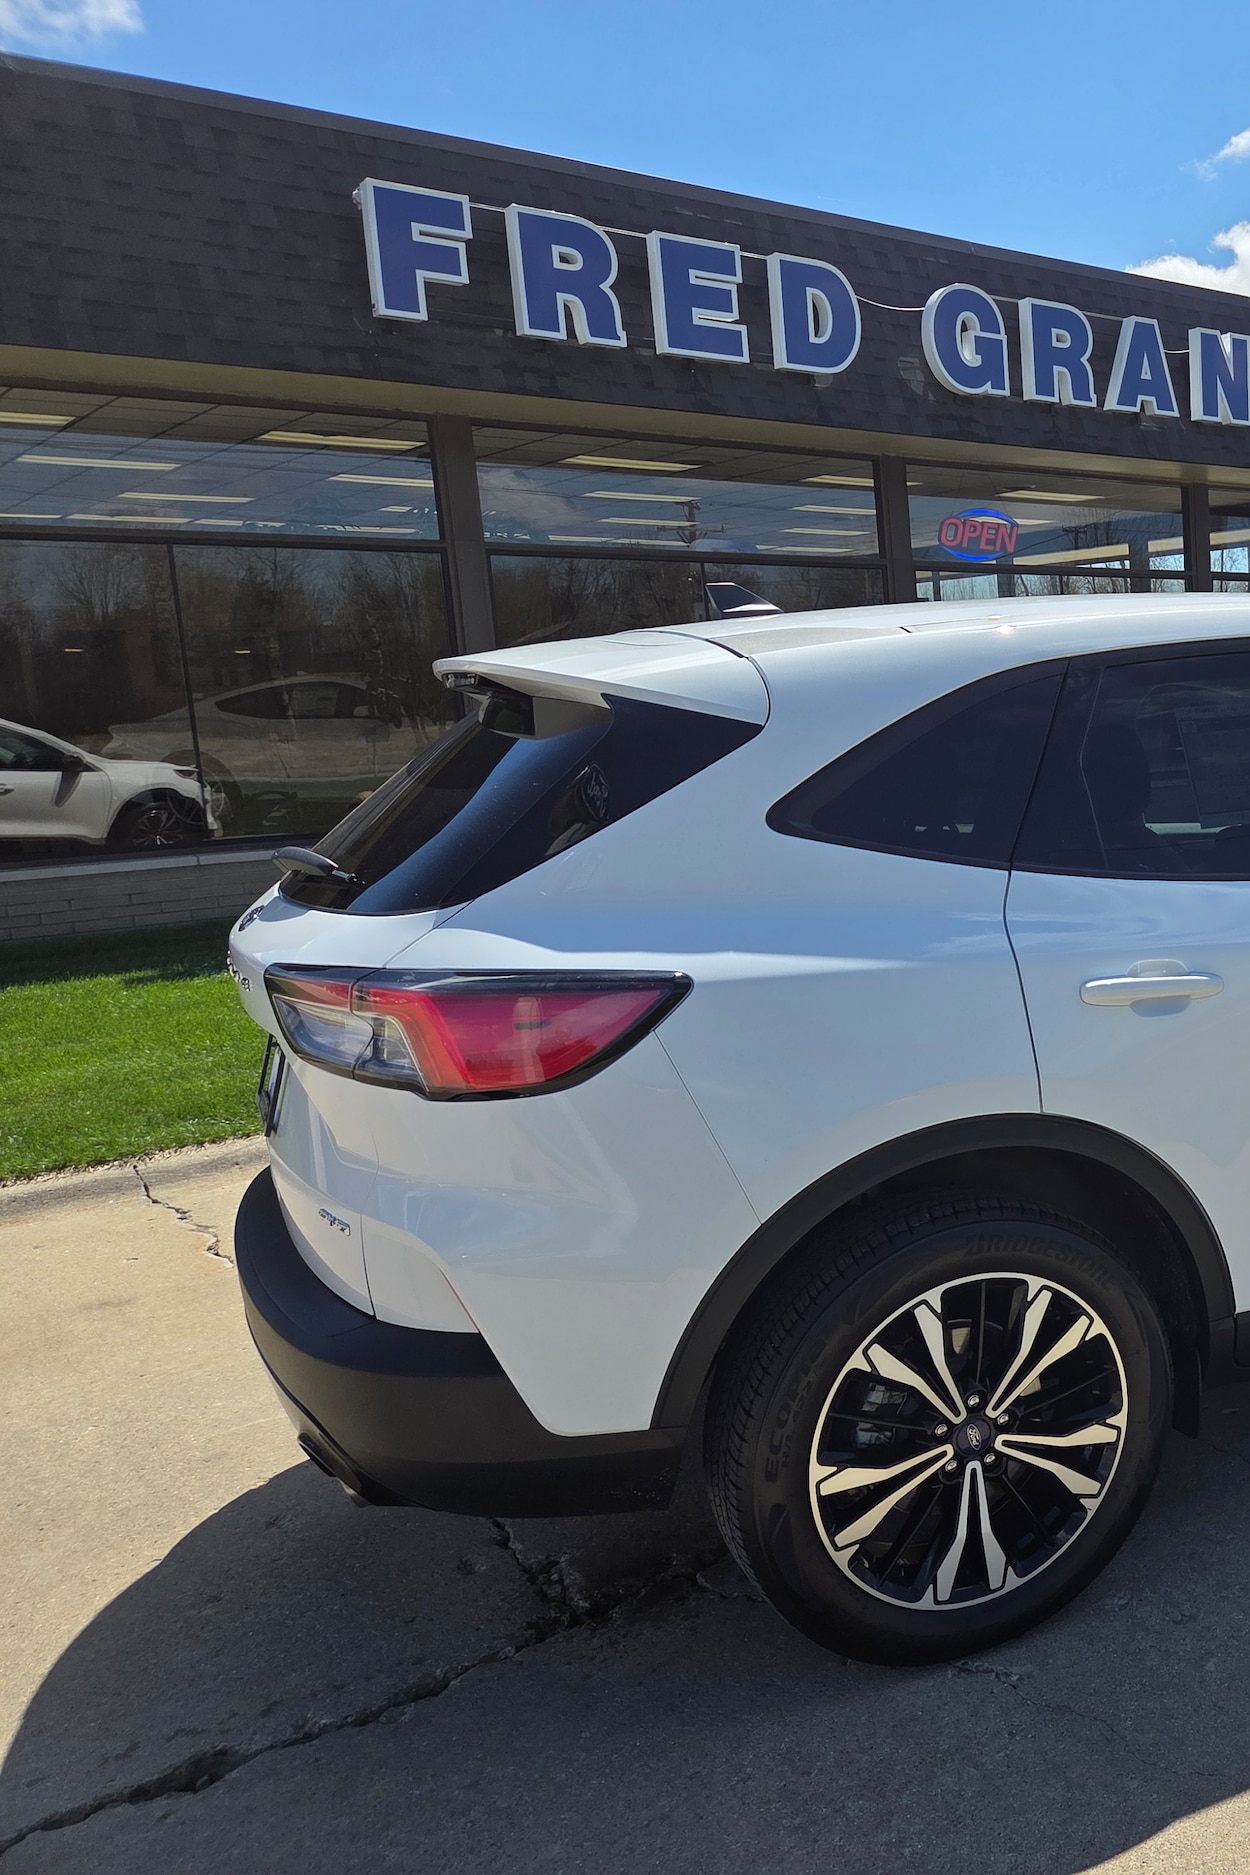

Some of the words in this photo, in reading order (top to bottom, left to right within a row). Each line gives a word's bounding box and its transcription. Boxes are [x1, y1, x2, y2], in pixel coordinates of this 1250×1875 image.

[359, 177, 861, 374] FRED
[940, 517, 1018, 553] OPEN
[962, 1232, 1117, 1291] BRIDGESTONE
[967, 1426, 981, 1448] Ford
